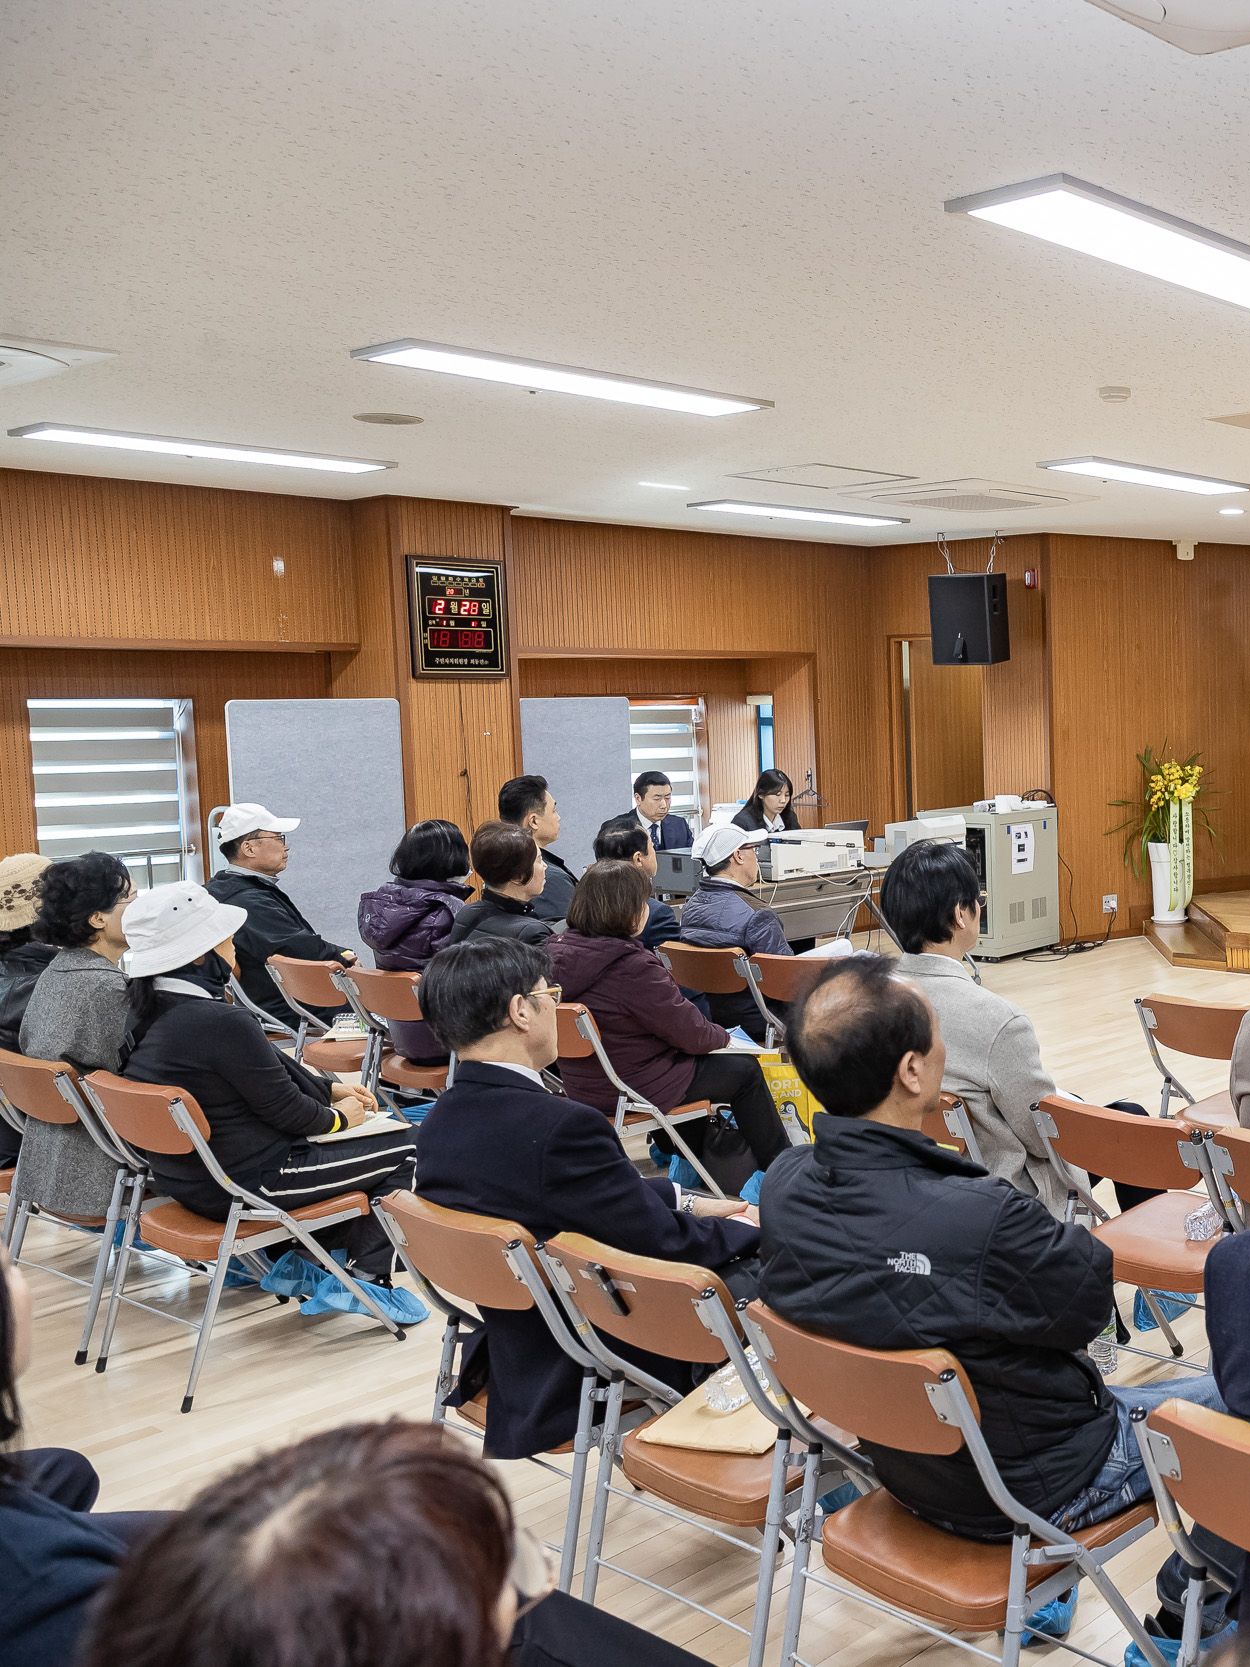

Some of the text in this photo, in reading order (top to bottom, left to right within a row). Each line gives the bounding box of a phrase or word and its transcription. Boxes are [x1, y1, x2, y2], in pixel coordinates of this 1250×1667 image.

[460, 601, 479, 615] 28
[899, 1251, 917, 1260] THE
[887, 1257, 917, 1267] NORTH
[894, 1265, 917, 1274] FACE
